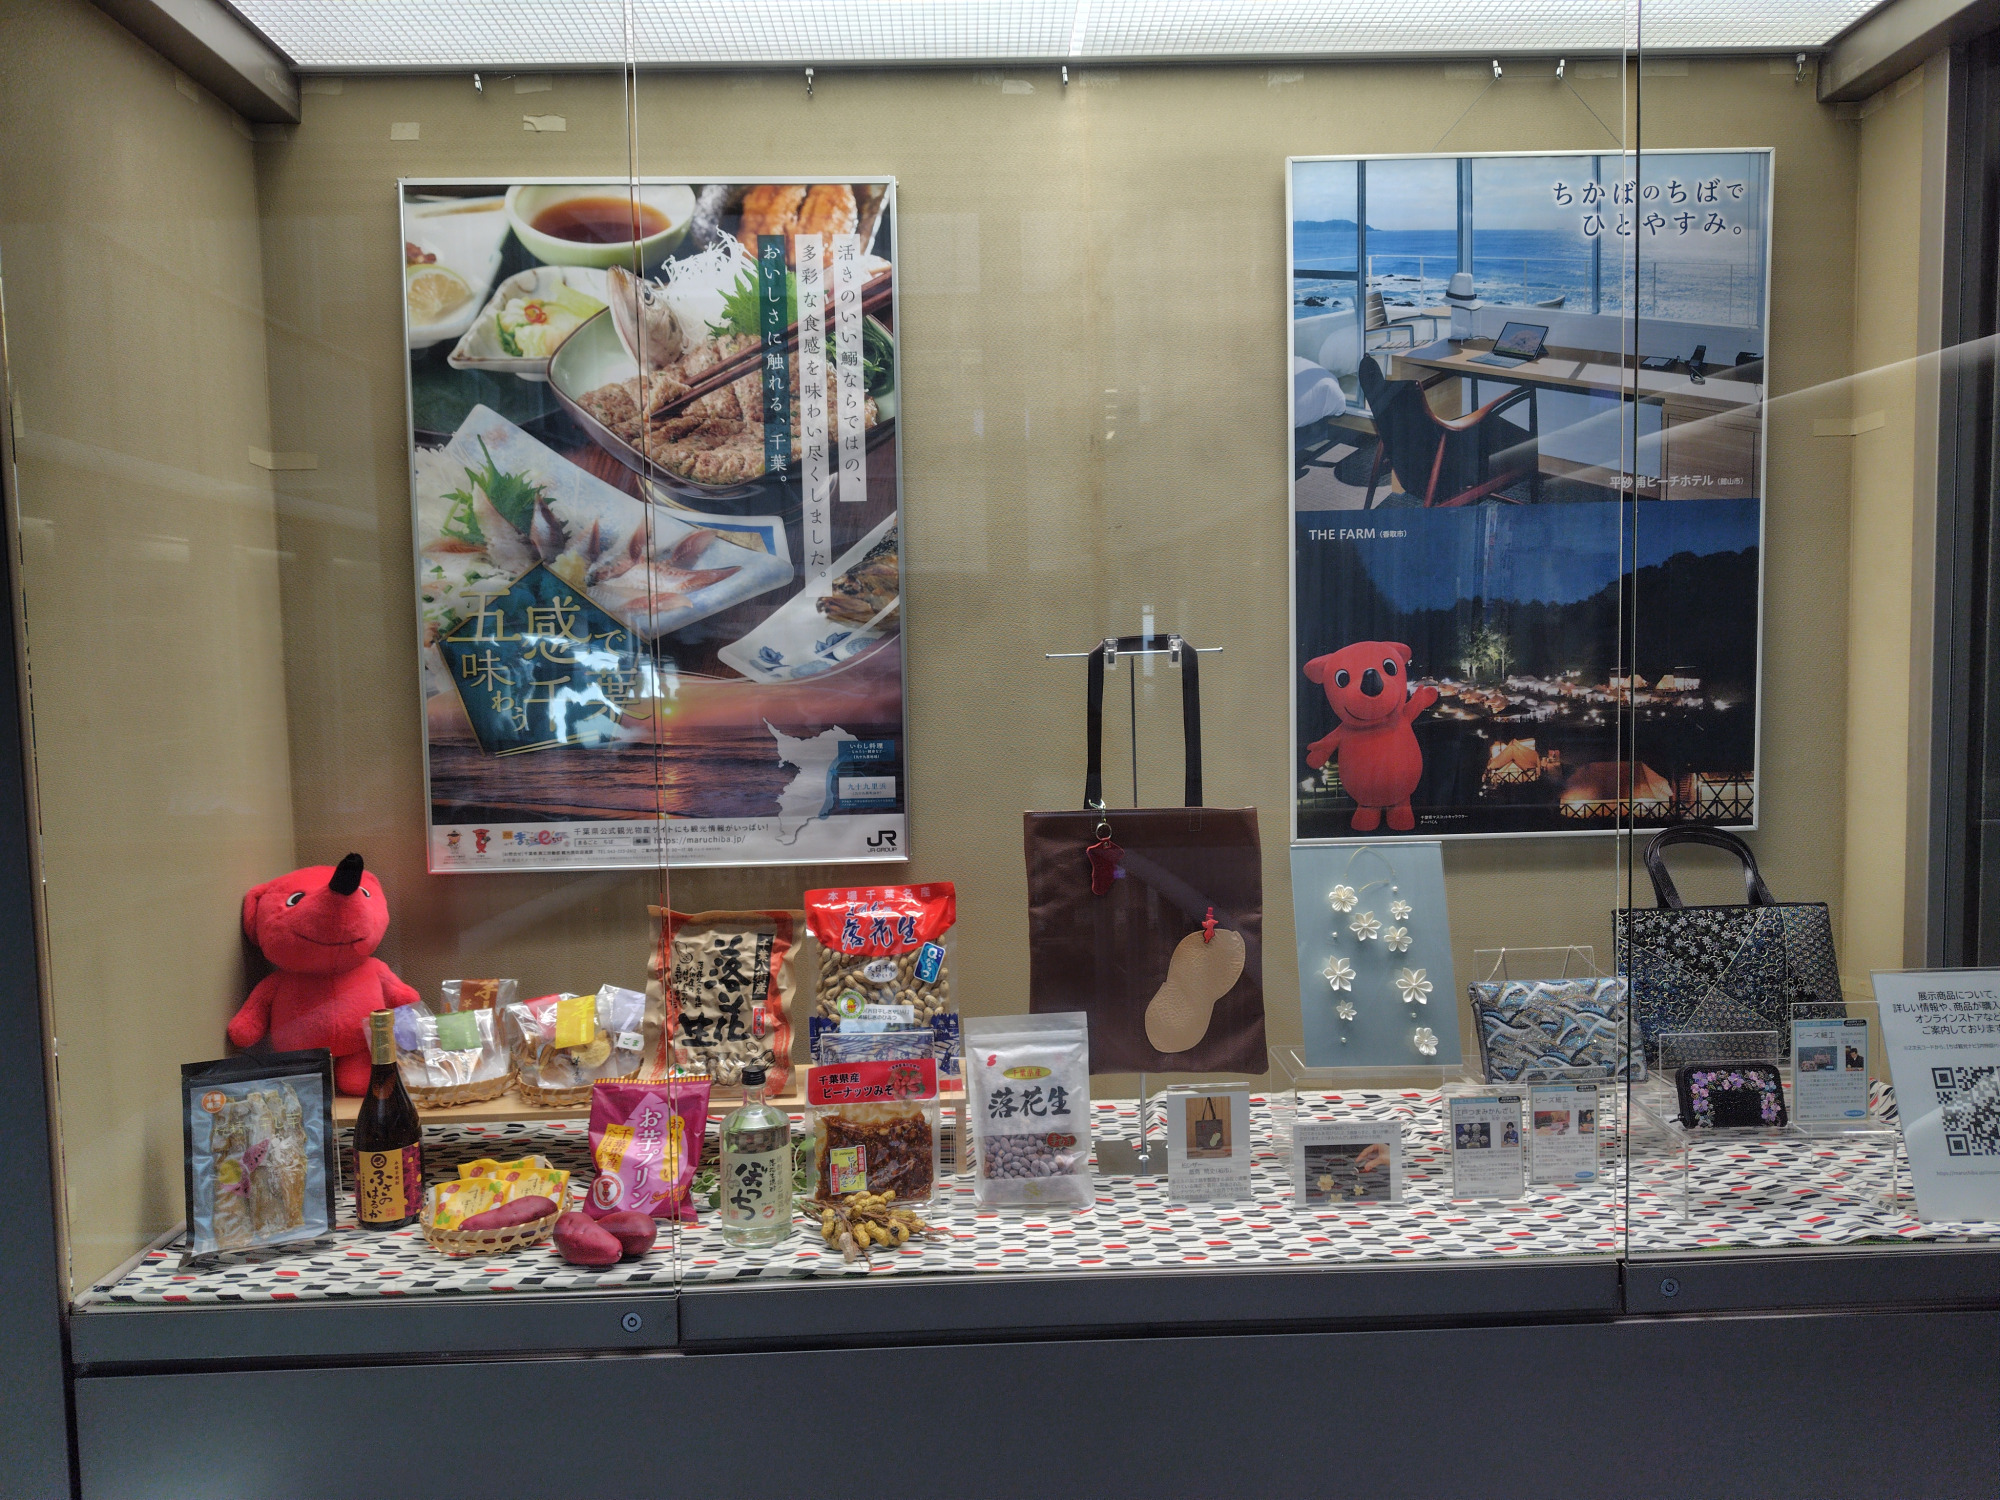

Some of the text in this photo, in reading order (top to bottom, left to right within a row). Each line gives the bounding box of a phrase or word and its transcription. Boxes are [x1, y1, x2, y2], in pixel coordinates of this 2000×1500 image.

[1553, 178, 1745, 206] ちかばのちばで
[1582, 211, 1743, 236] ひとやすみ。
[762, 244, 788, 482] おいしさに触れる、千葉。
[837, 244, 862, 483] 活きのいい鰯ならではの、
[801, 244, 827, 578] 多彩な食感を味わい尽くしました。
[1309, 529, 1336, 540] THE
[1339, 528, 1376, 540] FARM
[447, 588, 627, 664] 五感で
[461, 649, 653, 732] 味わう 千葉
[653, 835, 746, 846] https://maruchiba.jp/
[866, 830, 897, 847] JR
[827, 887, 931, 902] 本場千葉名産
[842, 915, 918, 951] 落花生
[754, 938, 771, 995] 千葉八街産
[678, 935, 752, 1048] 落花生
[1918, 990, 1998, 1001] 展示商品について、
[818, 1073, 860, 1086] 千葉県産
[823, 1085, 895, 1099] ピーナッツみそ
[987, 1086, 1072, 1119] 落花生
[606, 1128, 633, 1169] 千葉県産
[630, 1107, 663, 1209] お芋プリン
[730, 1161, 768, 1221] ぼっち
